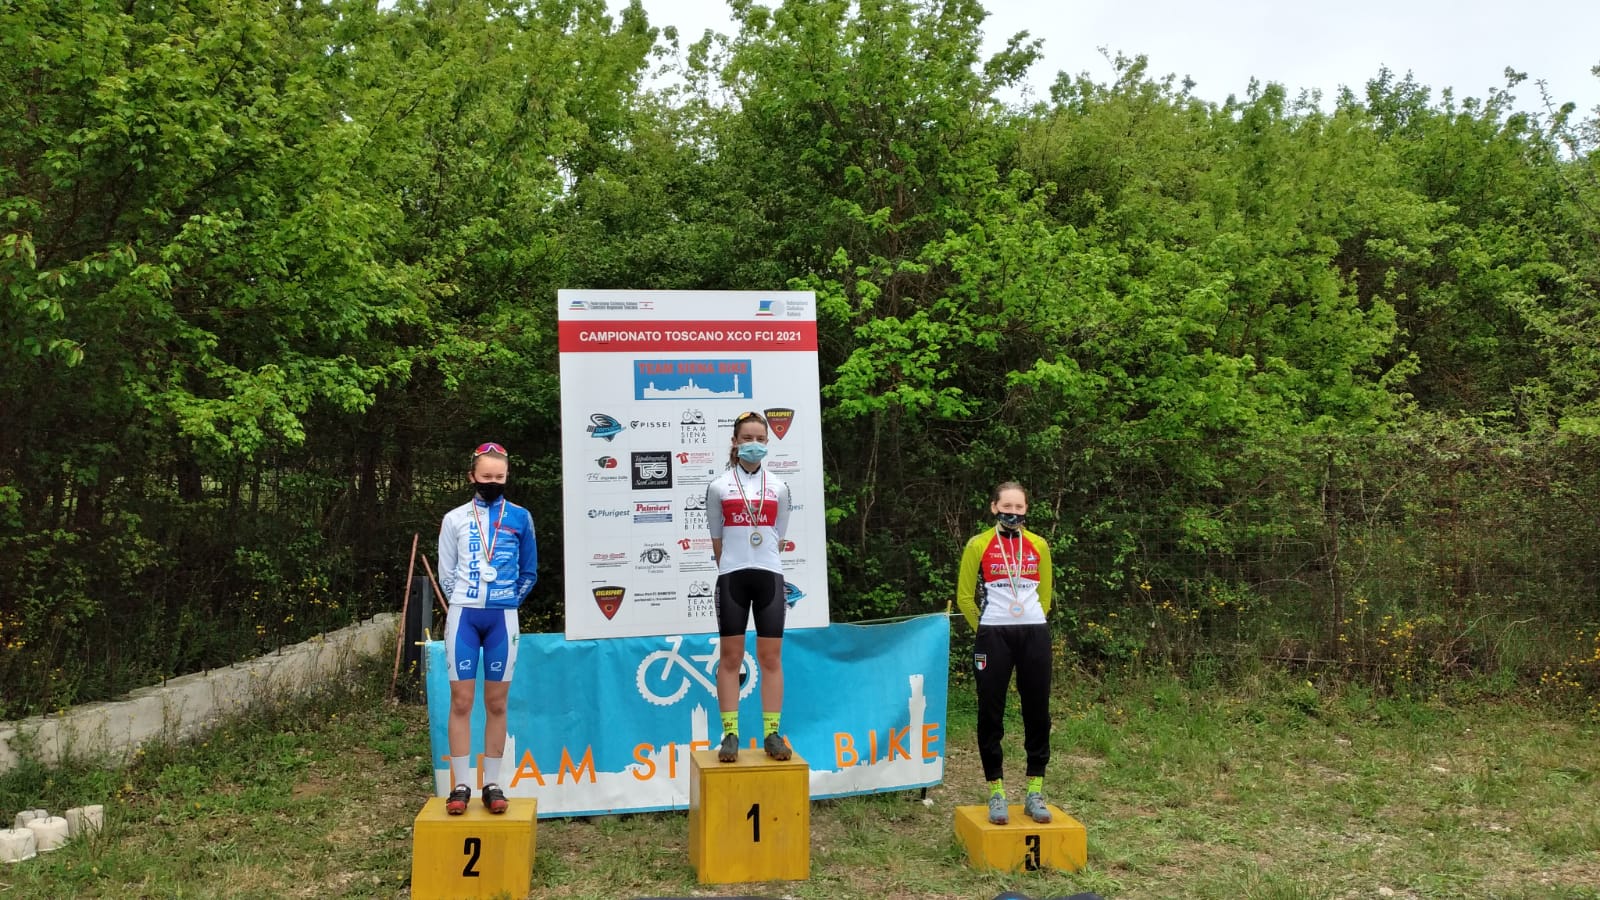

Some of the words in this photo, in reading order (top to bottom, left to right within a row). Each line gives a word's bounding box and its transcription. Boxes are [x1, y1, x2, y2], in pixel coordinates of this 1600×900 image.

[579, 331, 662, 342] CAMPIONATO
[665, 331, 724, 342] TOSCANO
[726, 331, 752, 341] XCO
[755, 331, 774, 341] FCI
[776, 331, 801, 341] 2021
[638, 363, 674, 375] TEAM
[677, 363, 715, 375] SIENA
[719, 362, 748, 374] BIKE
[597, 509, 630, 518] Plurigest
[635, 503, 671, 512] Palmieri
[833, 722, 940, 769] BIKE
[746, 803, 761, 843] 1
[463, 837, 481, 878] 2
[1025, 834, 1041, 871] 3
